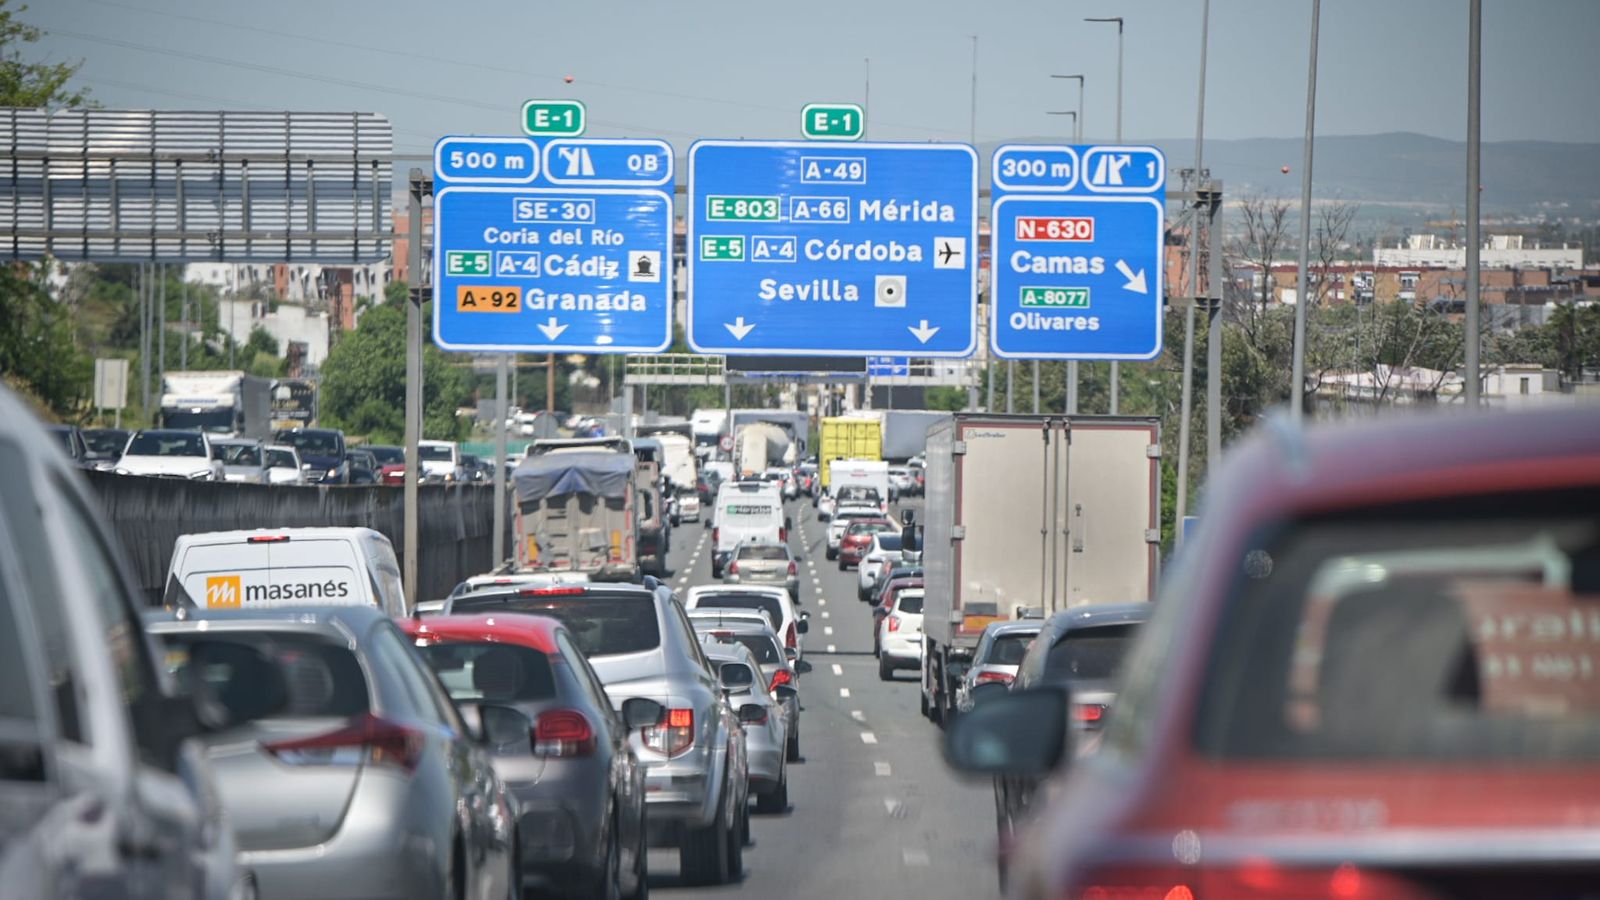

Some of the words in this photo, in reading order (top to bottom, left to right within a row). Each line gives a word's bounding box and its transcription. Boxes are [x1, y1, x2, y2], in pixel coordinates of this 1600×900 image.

[535, 109, 573, 127] E-1
[814, 113, 852, 131] E-1
[451, 151, 497, 169] 500
[504, 155, 525, 170] m
[805, 161, 862, 179] A-49
[1002, 159, 1047, 178] 300
[1051, 163, 1072, 178] m
[1146, 161, 1156, 179] 1
[518, 201, 591, 220] SE-30
[711, 199, 778, 218] E-803
[794, 201, 846, 219] A-66
[859, 199, 956, 222] Mérida
[484, 227, 540, 244] Coria
[549, 228, 583, 245] del
[591, 229, 624, 246] Río
[1018, 220, 1090, 239] N-630
[703, 239, 741, 257] E-5
[754, 240, 794, 258] A-4
[804, 238, 923, 263] Córdoba
[449, 255, 488, 272] E-5
[499, 255, 538, 272] A-4
[544, 253, 620, 278] Cádiz
[1010, 250, 1105, 275] Camas
[461, 290, 517, 308] A-92
[525, 287, 647, 312] Granada
[758, 278, 860, 302] Sevilla
[1023, 289, 1087, 306] A-8077
[1009, 312, 1100, 331] Olivares
[245, 579, 349, 601] masanés
